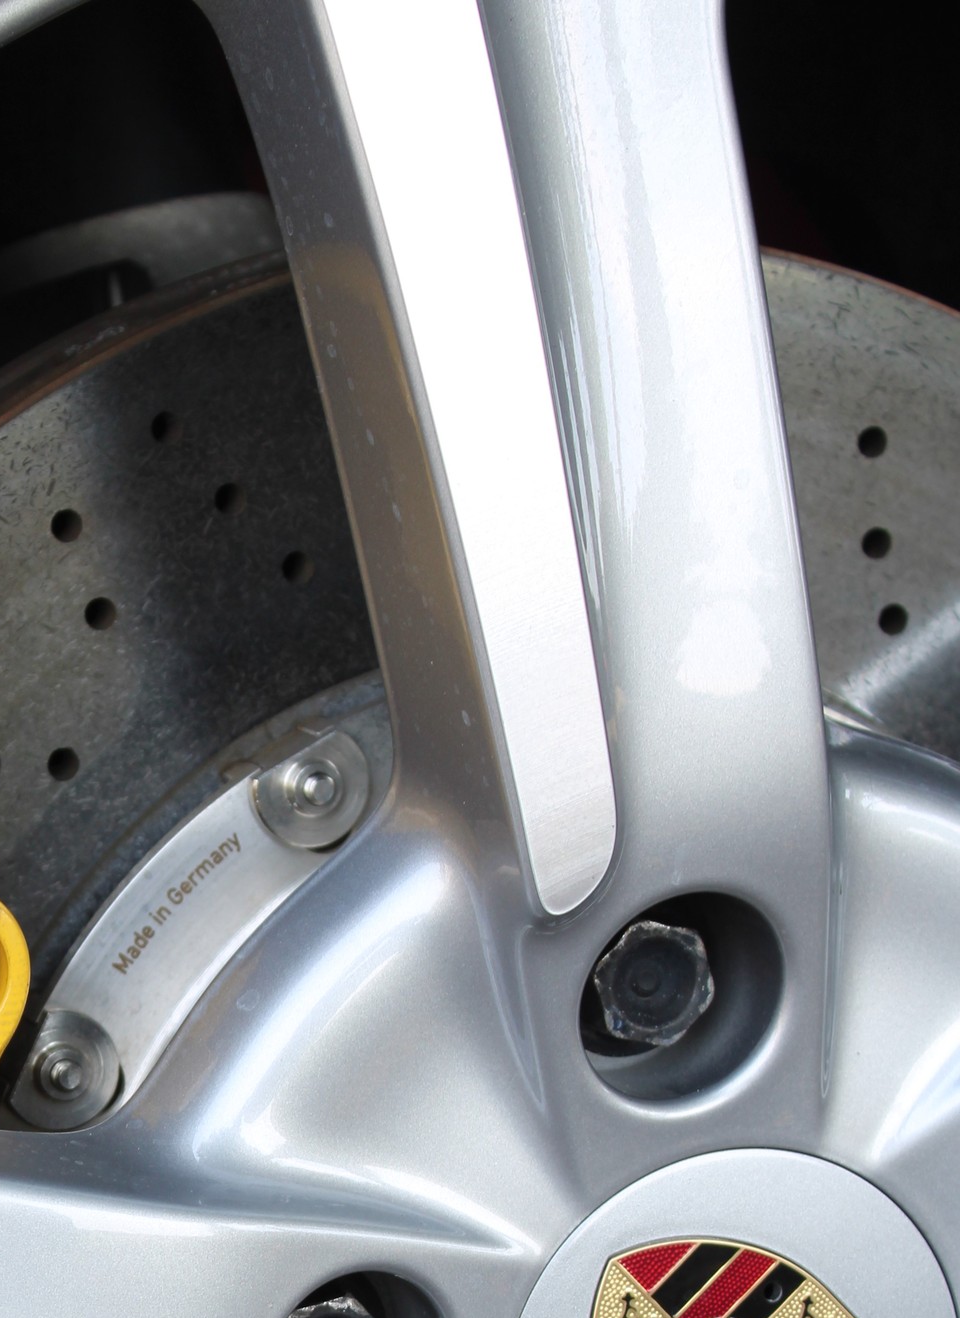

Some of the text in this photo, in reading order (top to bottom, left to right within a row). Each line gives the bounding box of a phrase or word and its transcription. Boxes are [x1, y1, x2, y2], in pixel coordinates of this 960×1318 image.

[112, 832, 242, 975] Made in Germany
